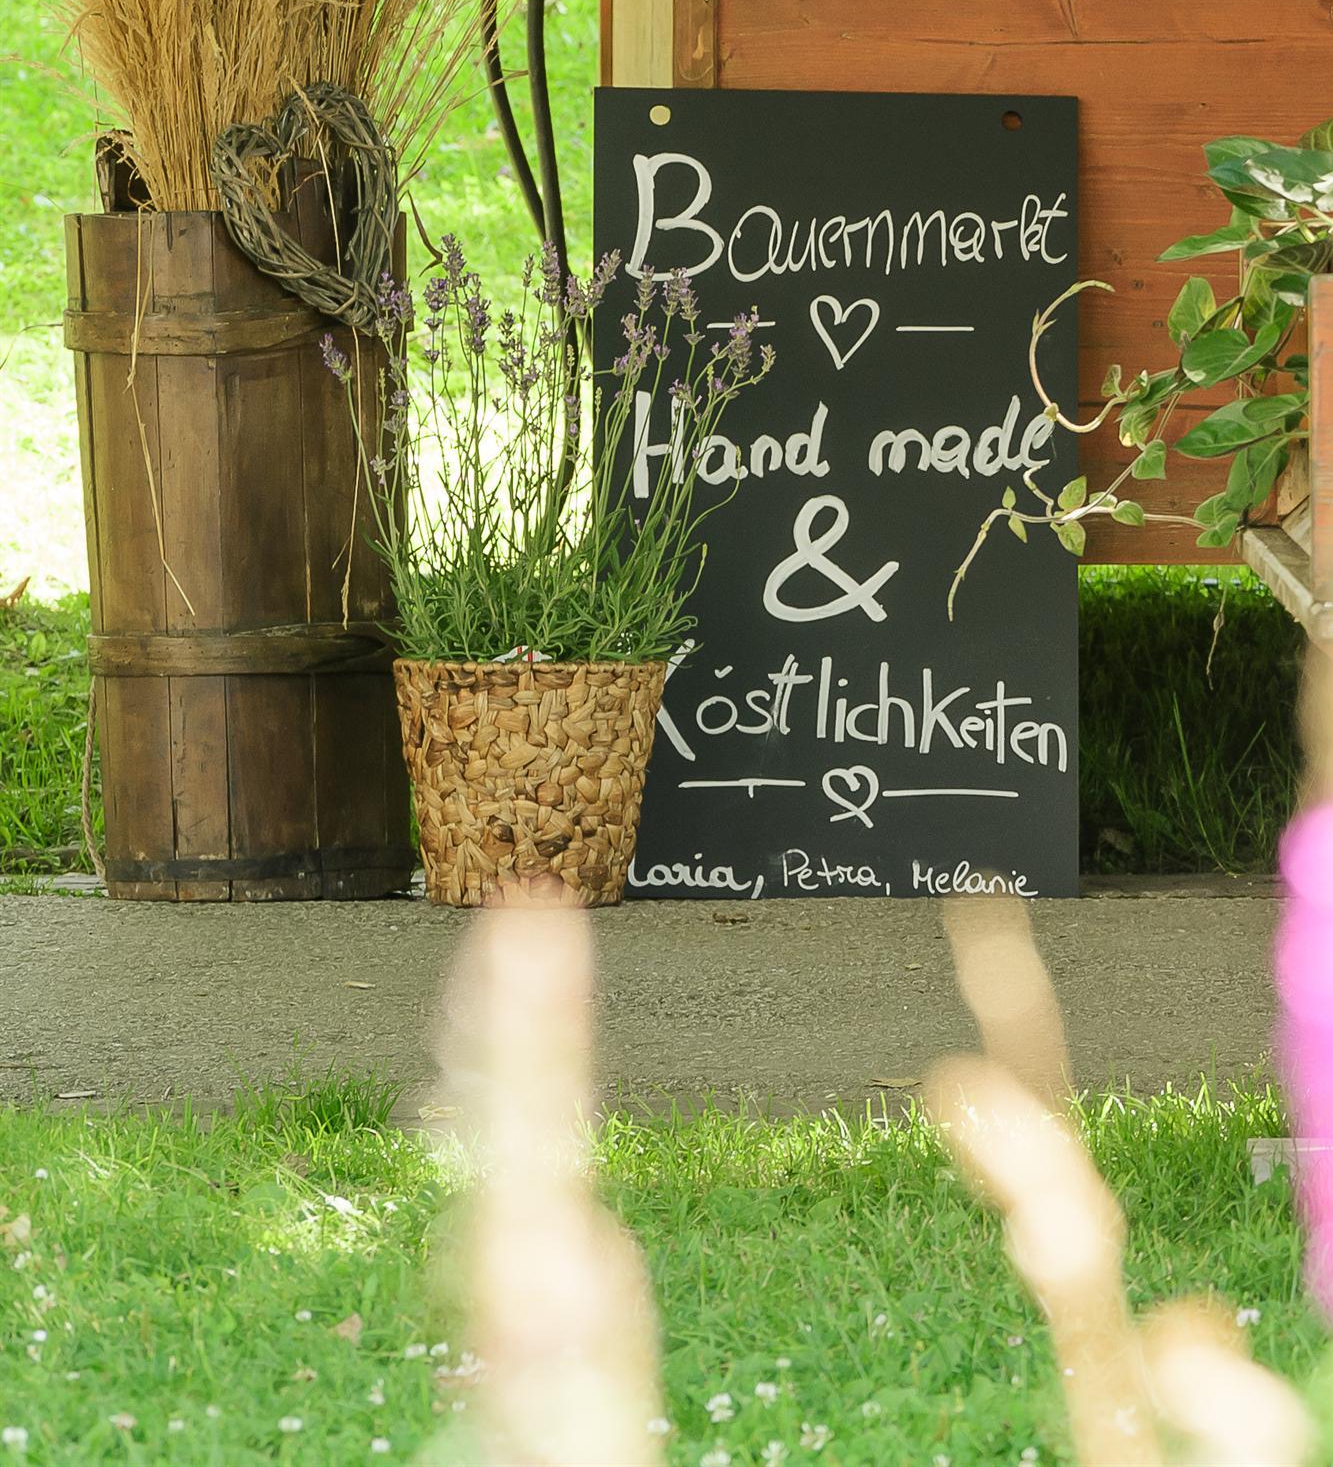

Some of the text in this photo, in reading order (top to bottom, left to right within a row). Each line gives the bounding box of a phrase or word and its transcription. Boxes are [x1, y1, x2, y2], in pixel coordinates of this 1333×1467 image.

[624, 152, 1068, 282] Bauernmarkt
[633, 390, 1058, 500] Hand made
[763, 494, 899, 622] &
[627, 848, 1040, 900] aria, Petra, Melanie
